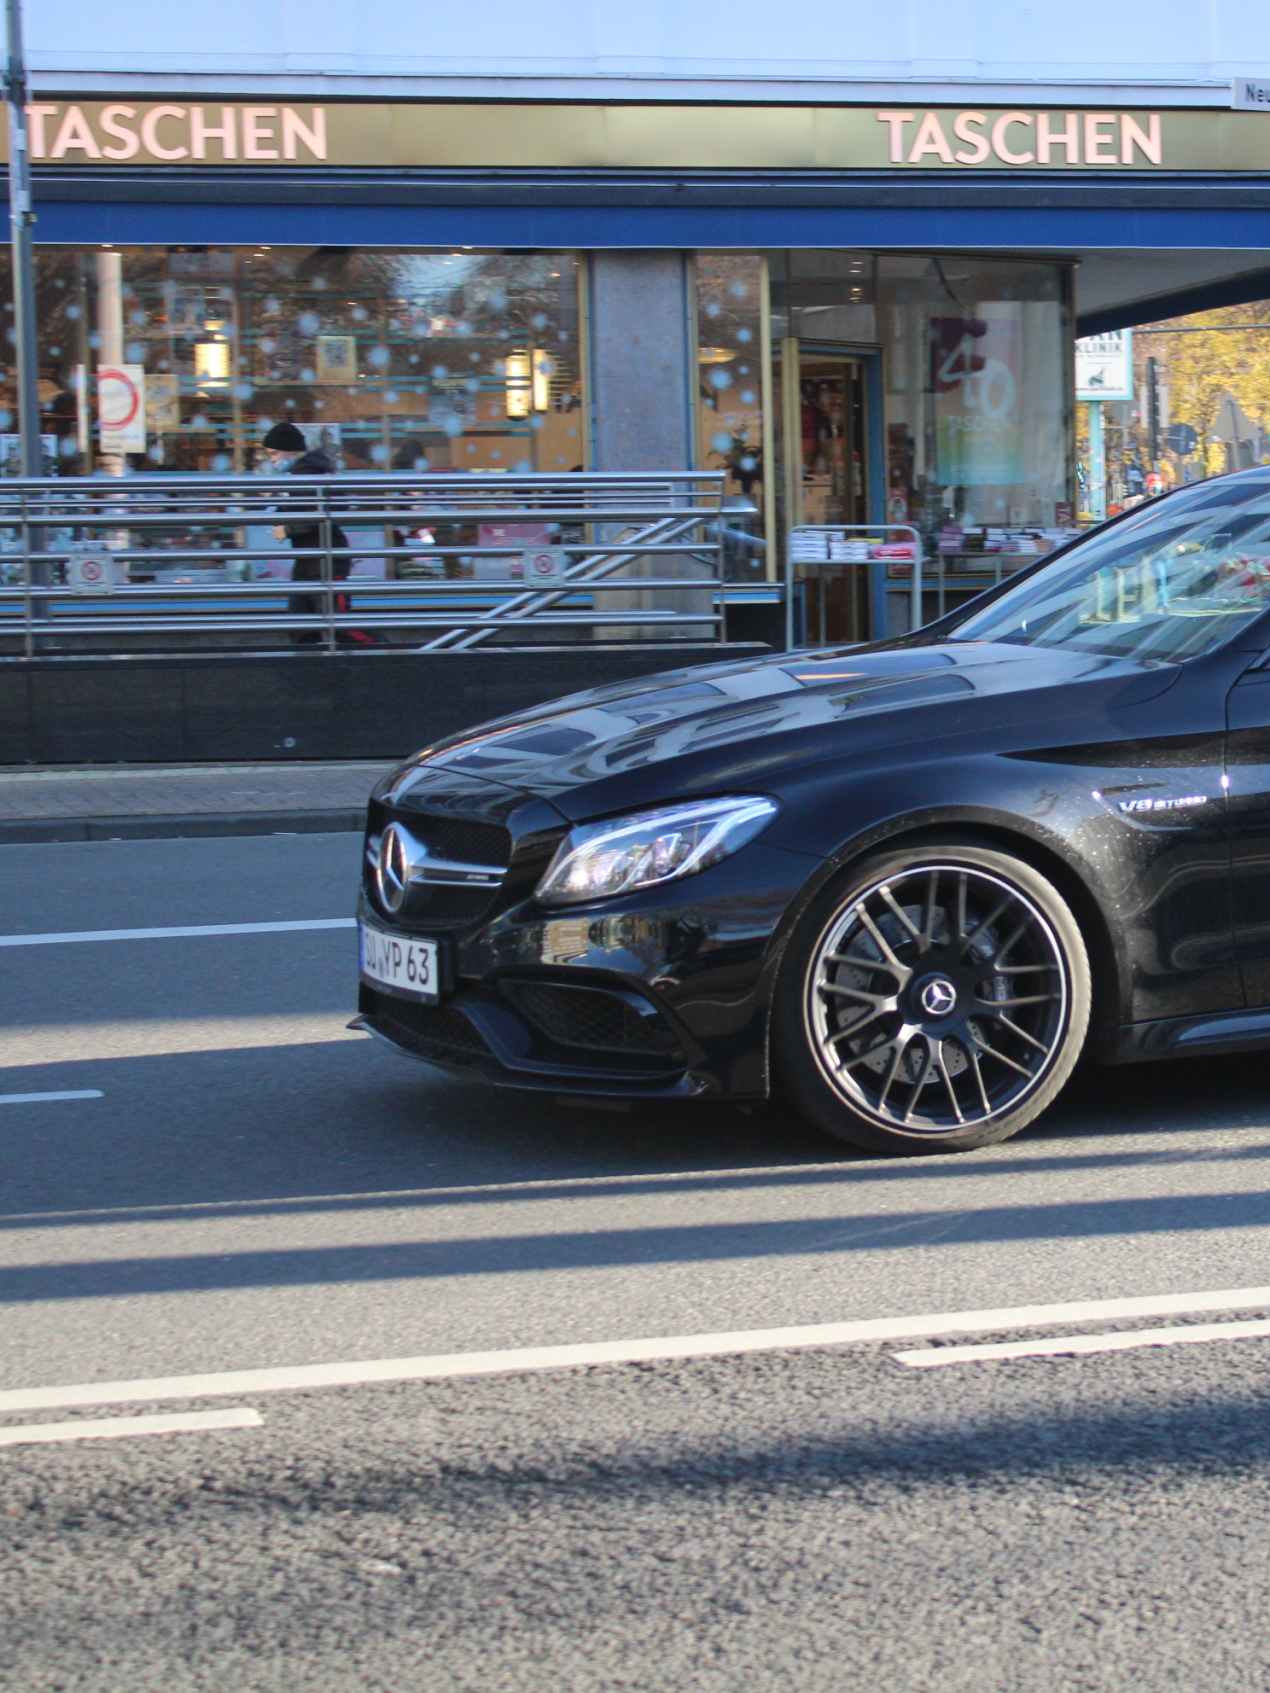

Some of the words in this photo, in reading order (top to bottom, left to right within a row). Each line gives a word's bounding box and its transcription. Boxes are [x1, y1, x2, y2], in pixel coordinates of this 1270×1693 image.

[25, 104, 328, 160] TASCHEN
[876, 111, 1162, 165] TASCHEN
[1075, 342, 1123, 354] KLINIK
